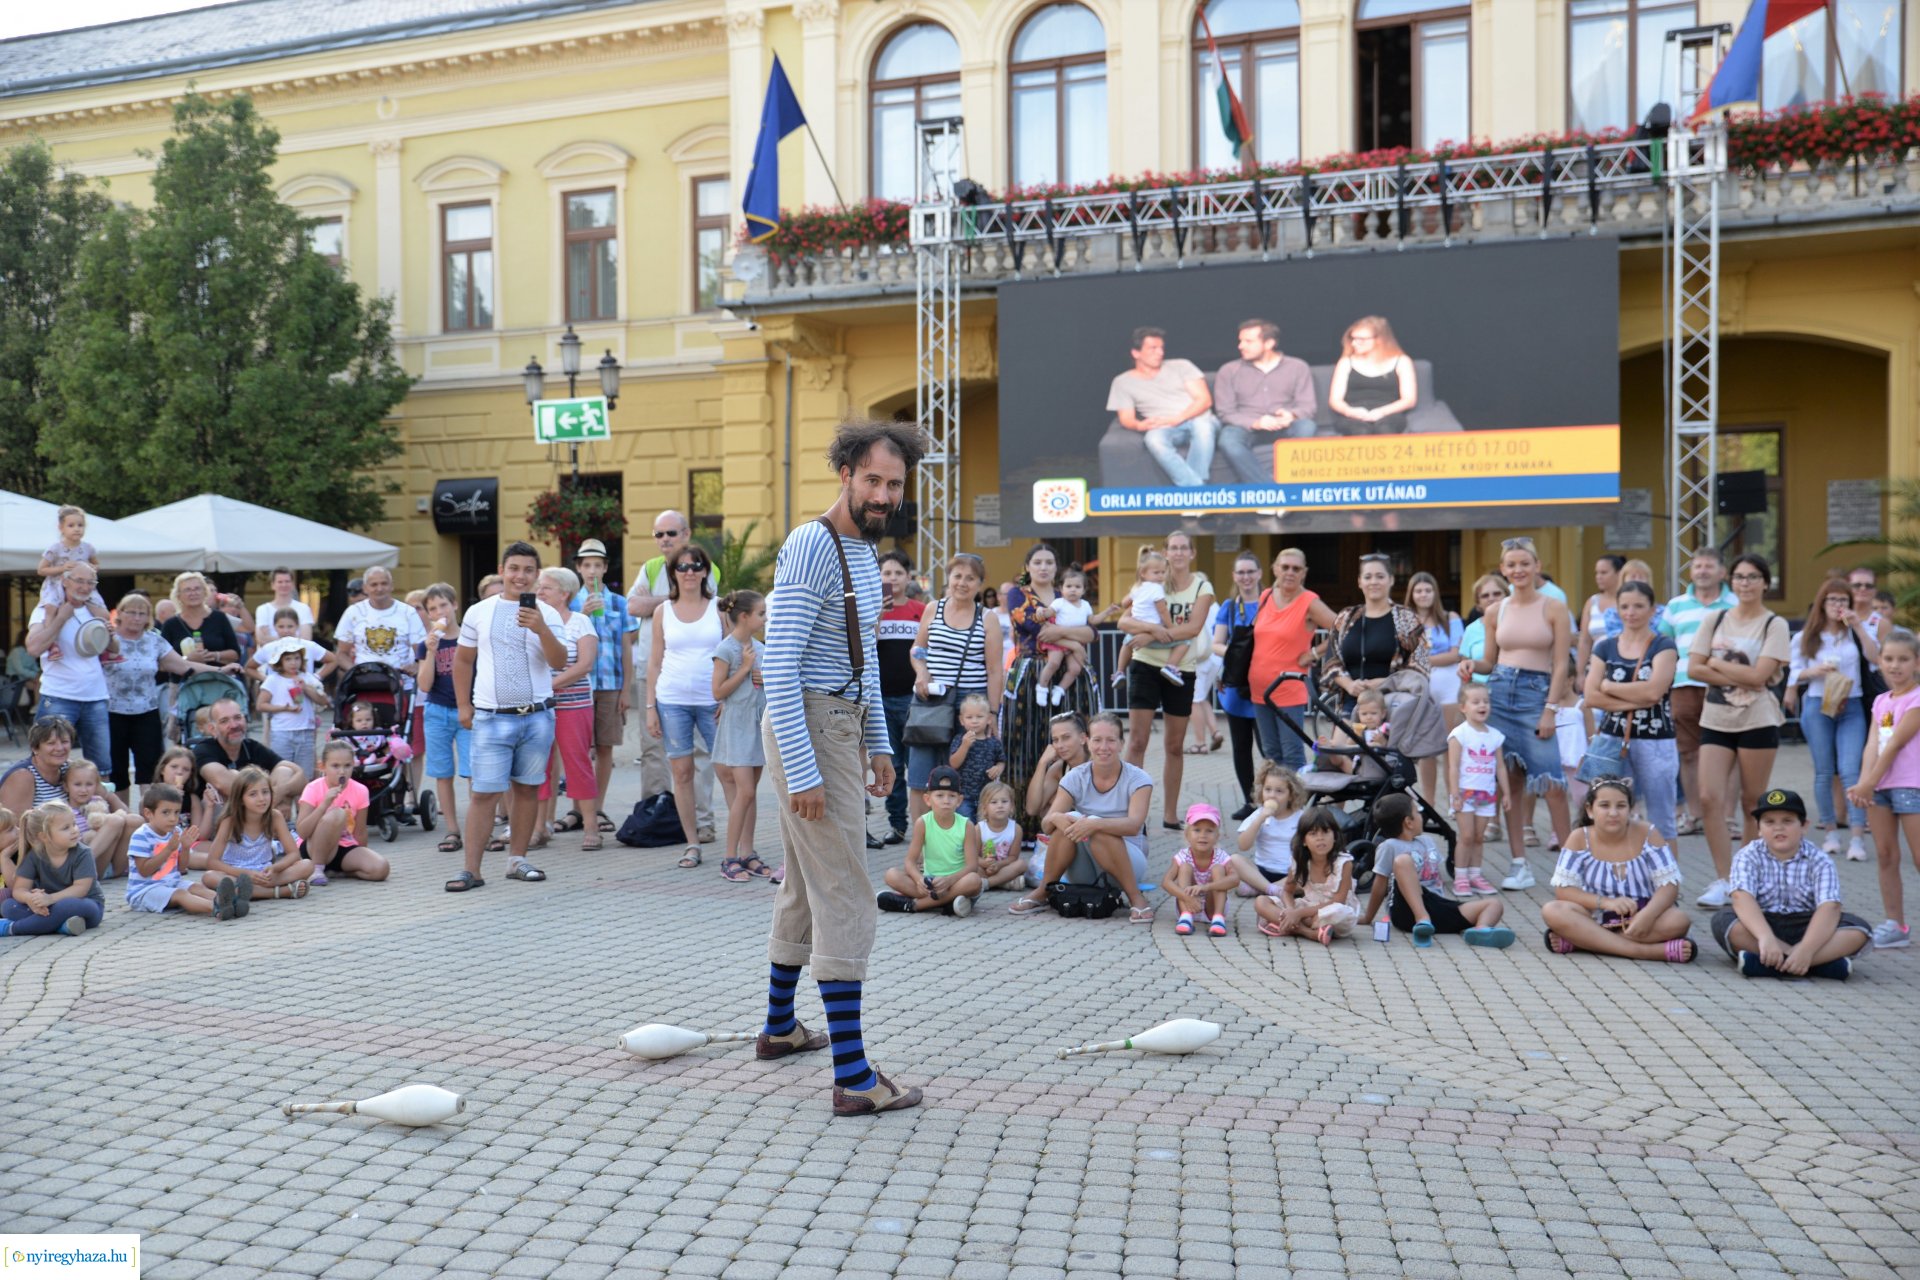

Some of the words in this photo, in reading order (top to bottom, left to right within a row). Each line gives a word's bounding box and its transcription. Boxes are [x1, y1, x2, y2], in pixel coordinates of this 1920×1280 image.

[1290, 445, 1387, 463] AUGUSZTUS
[1484, 439, 1531, 457] 17.00
[1100, 494, 1141, 508] ORLAI
[1145, 487, 1237, 507] PRODUKCIÓS
[1241, 489, 1286, 505] IRODA
[1301, 487, 1361, 503] MEGYEK
[1365, 482, 1427, 501] UTÁNAD
[879, 623, 918, 635] adidas
